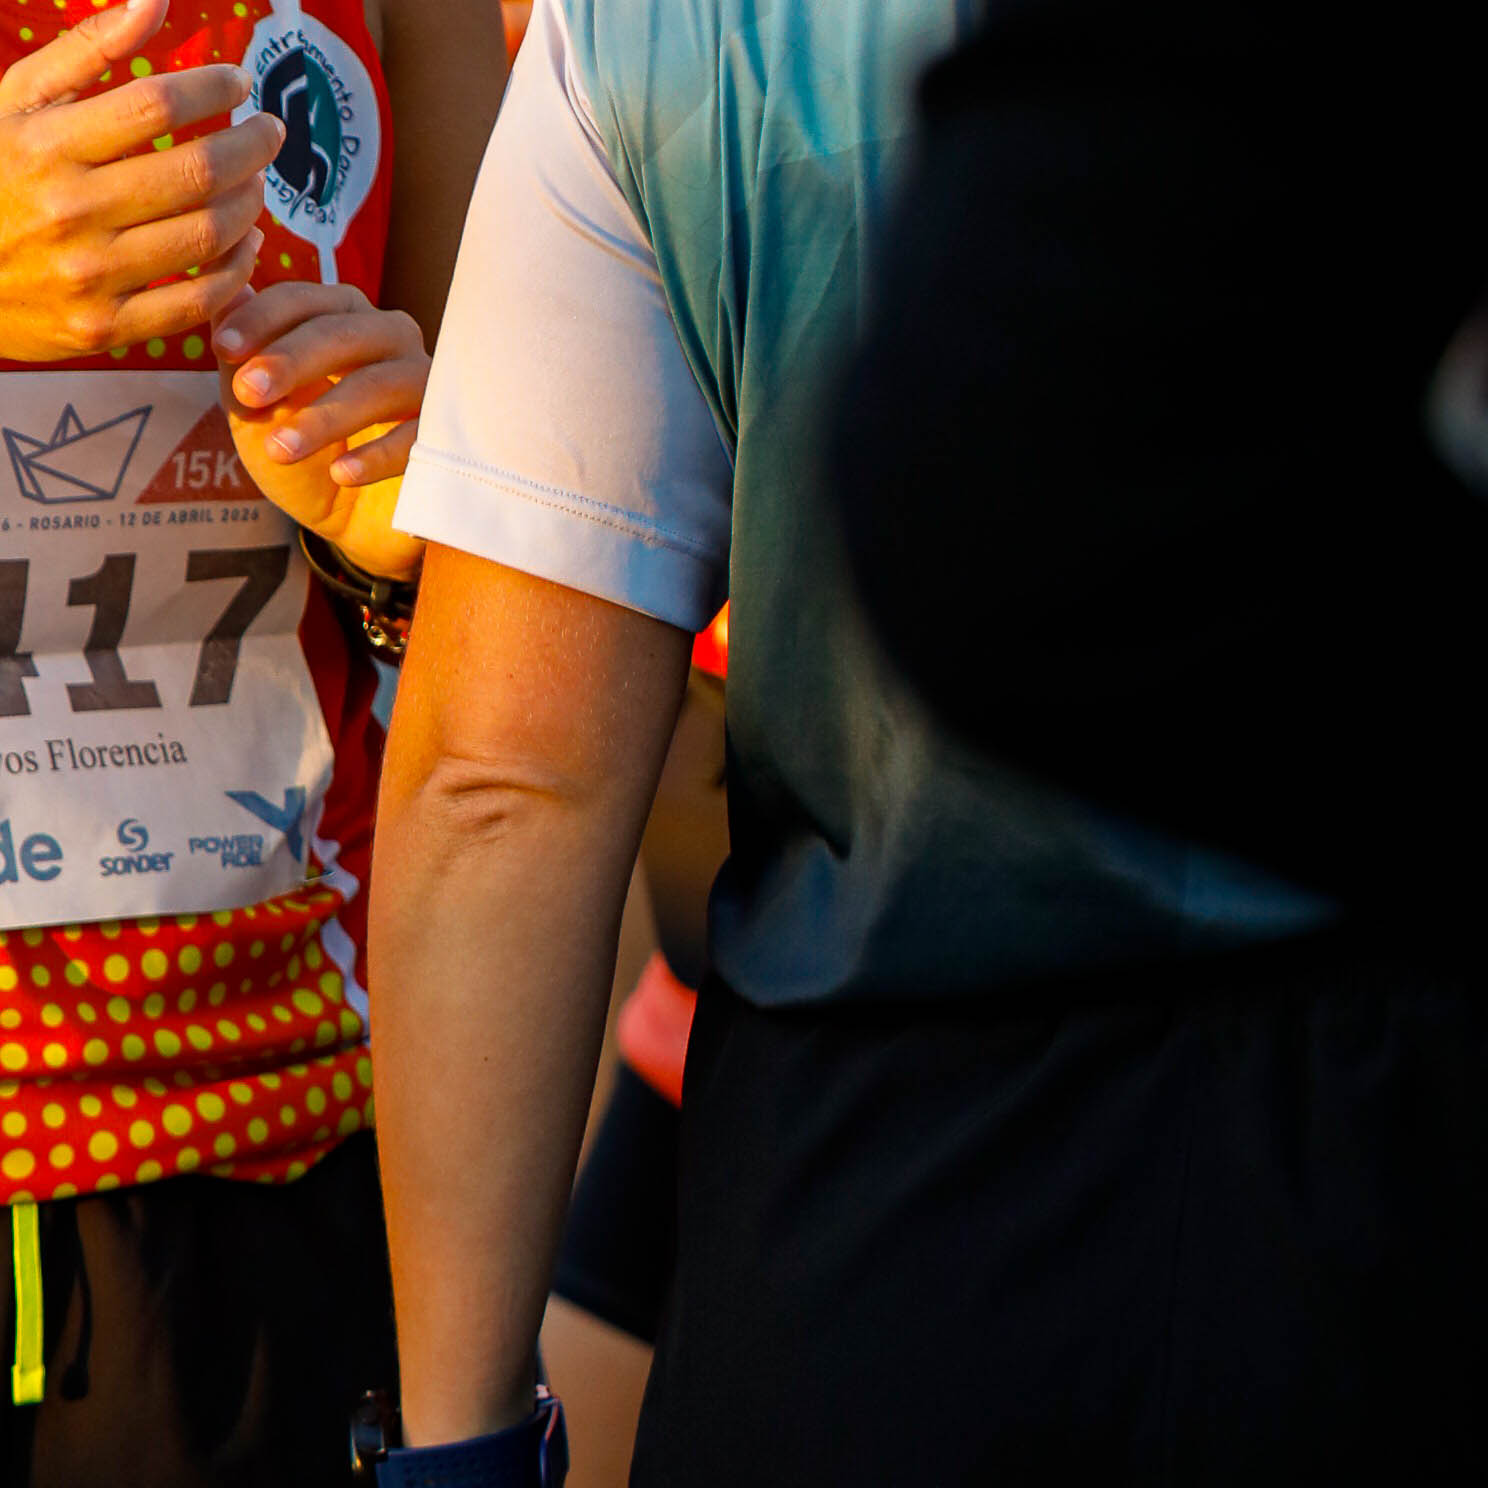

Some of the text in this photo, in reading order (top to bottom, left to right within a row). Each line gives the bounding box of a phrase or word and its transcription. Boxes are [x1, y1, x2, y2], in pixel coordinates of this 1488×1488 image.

[173, 450, 241, 489] 15K
[29, 513, 100, 531] ROSARIO
[119, 512, 136, 527] 12
[142, 511, 162, 526] DE
[167, 509, 215, 525] ABRIL
[221, 507, 260, 522] 2026
[44, 732, 188, 773] Florencia
